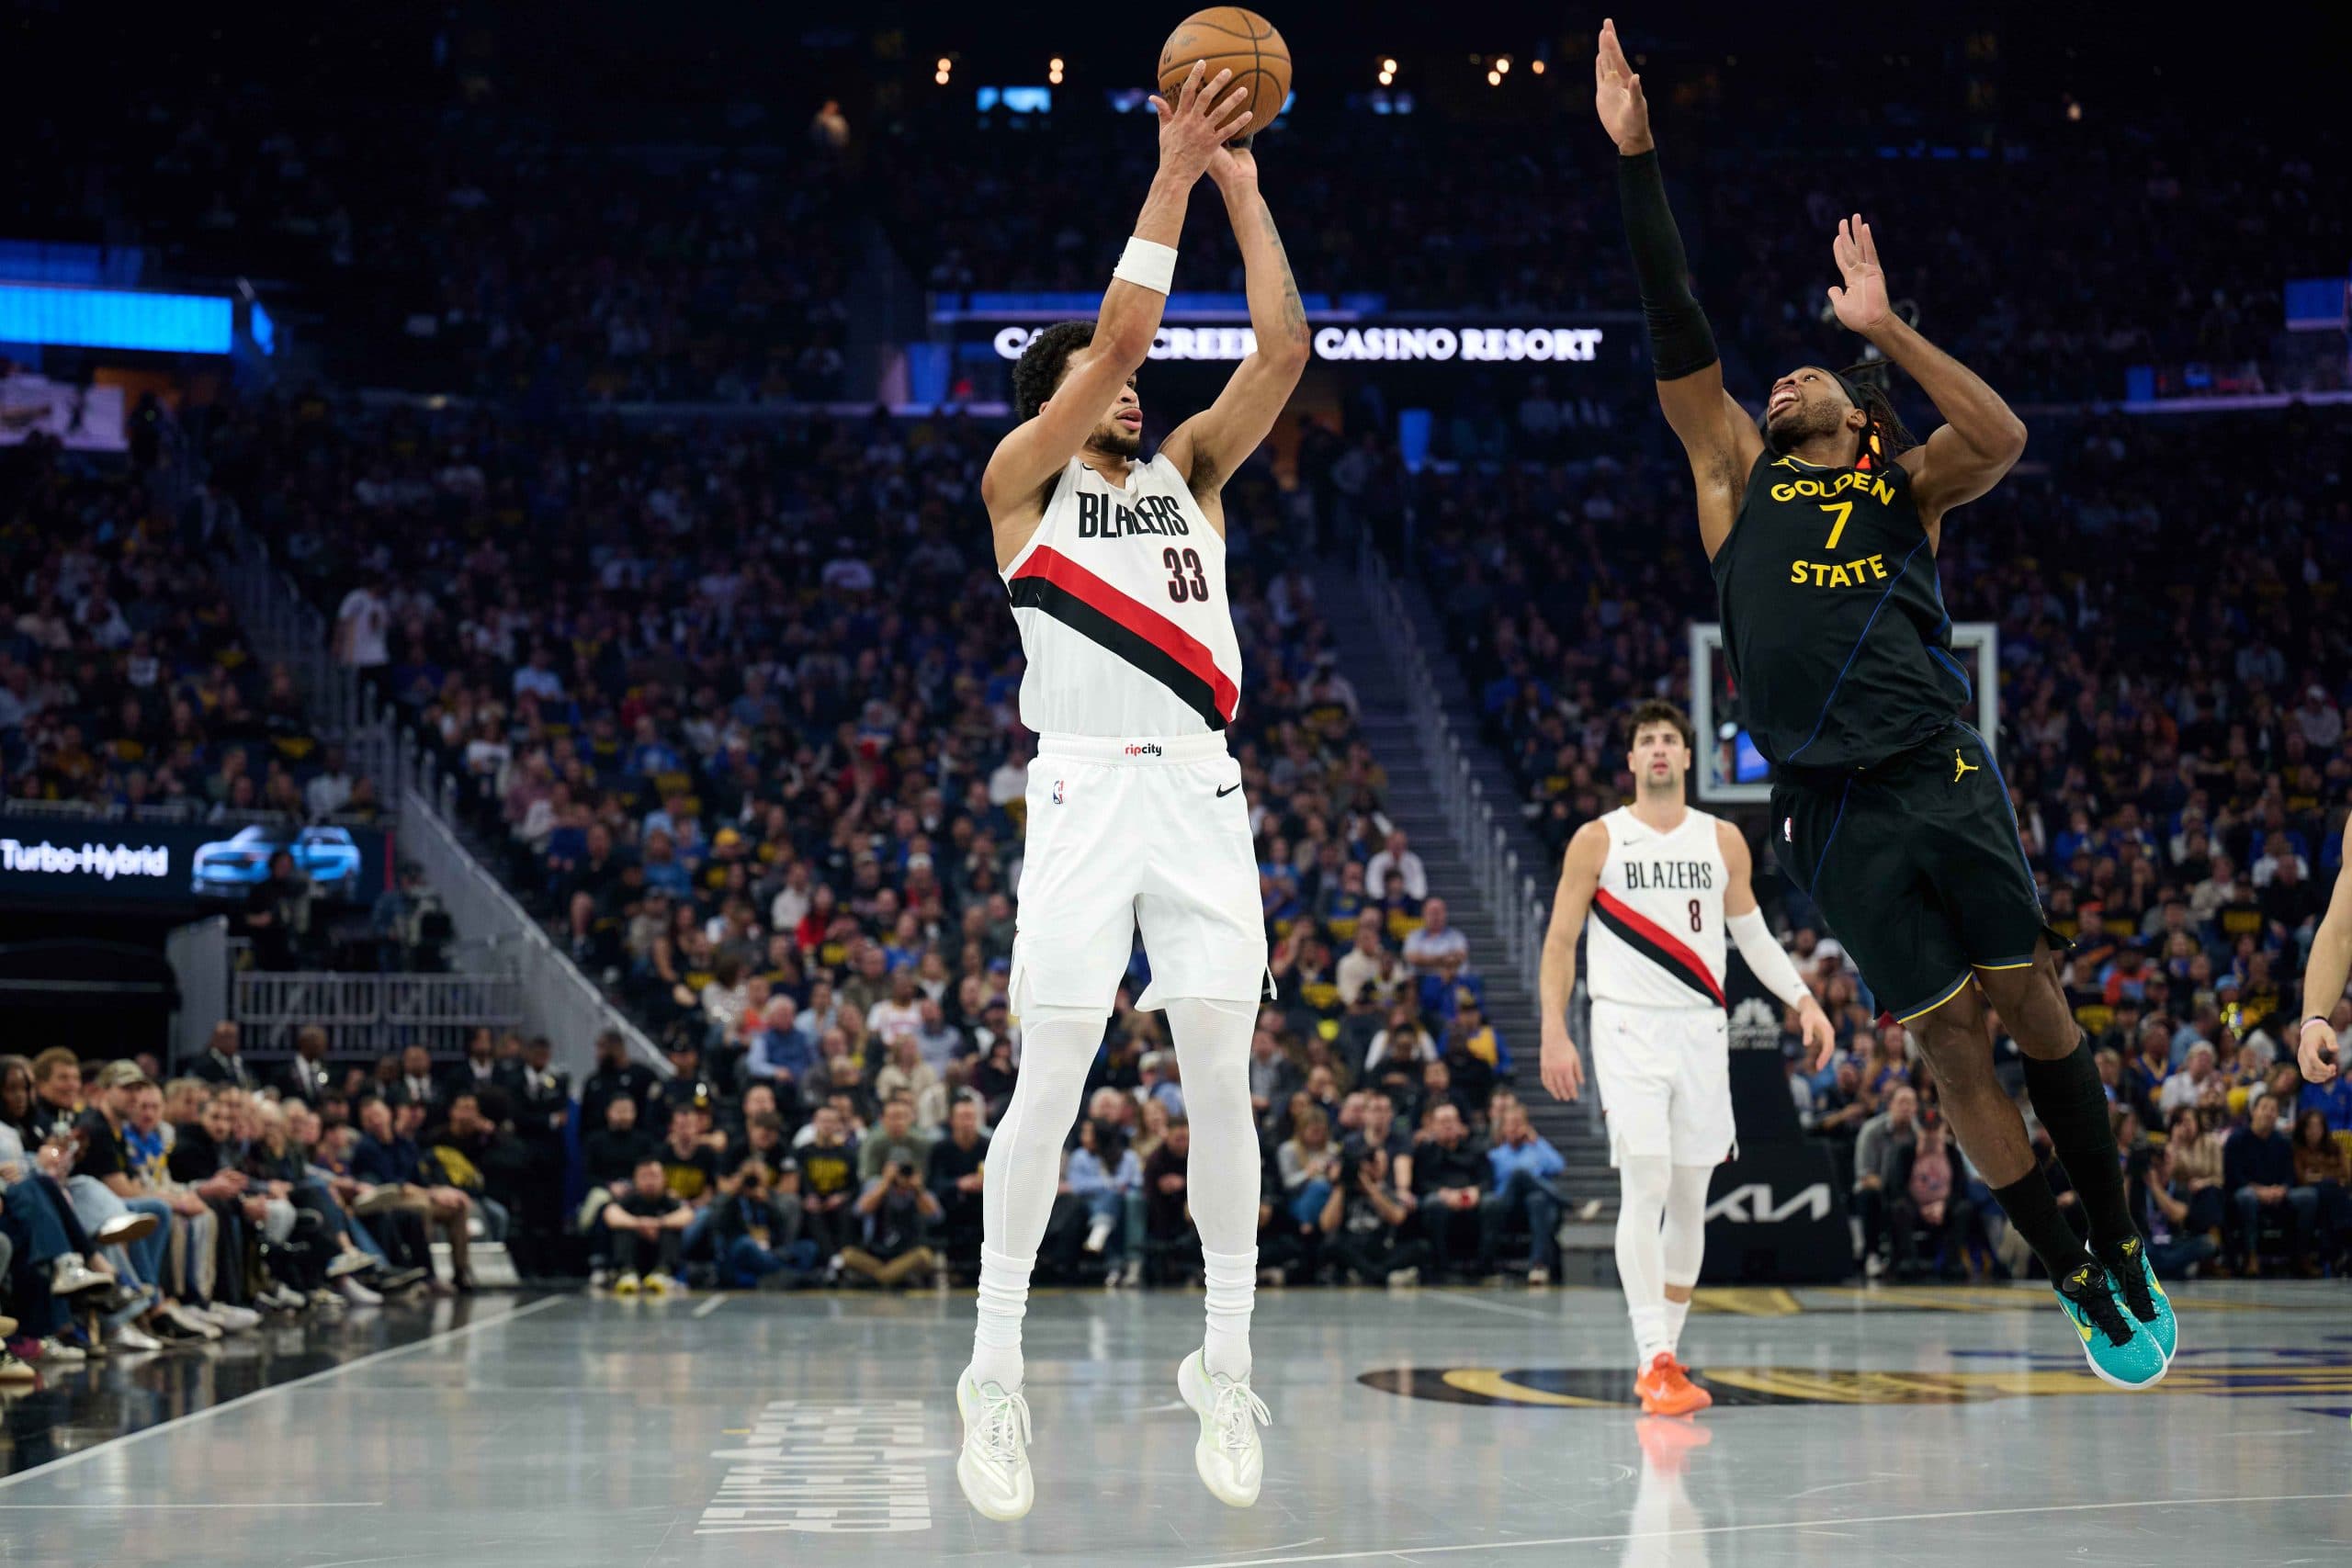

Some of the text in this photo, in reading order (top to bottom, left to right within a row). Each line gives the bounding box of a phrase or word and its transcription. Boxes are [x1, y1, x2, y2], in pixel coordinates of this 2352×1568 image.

[1314, 327, 1458, 361] CASINO
[1460, 328, 1602, 361] RESORT
[1770, 471, 1896, 506] GOLDEN
[1818, 501, 1853, 549] 7
[1162, 547, 1209, 603] 33
[1791, 554, 1888, 588] STATE
[1125, 742, 1162, 757] ripcity
[0, 839, 168, 881] Turbo-Hybrid
[1623, 861, 1712, 889] BLAZERS
[1688, 897, 1702, 933] 8
[693, 1464, 933, 1535] CENTER
